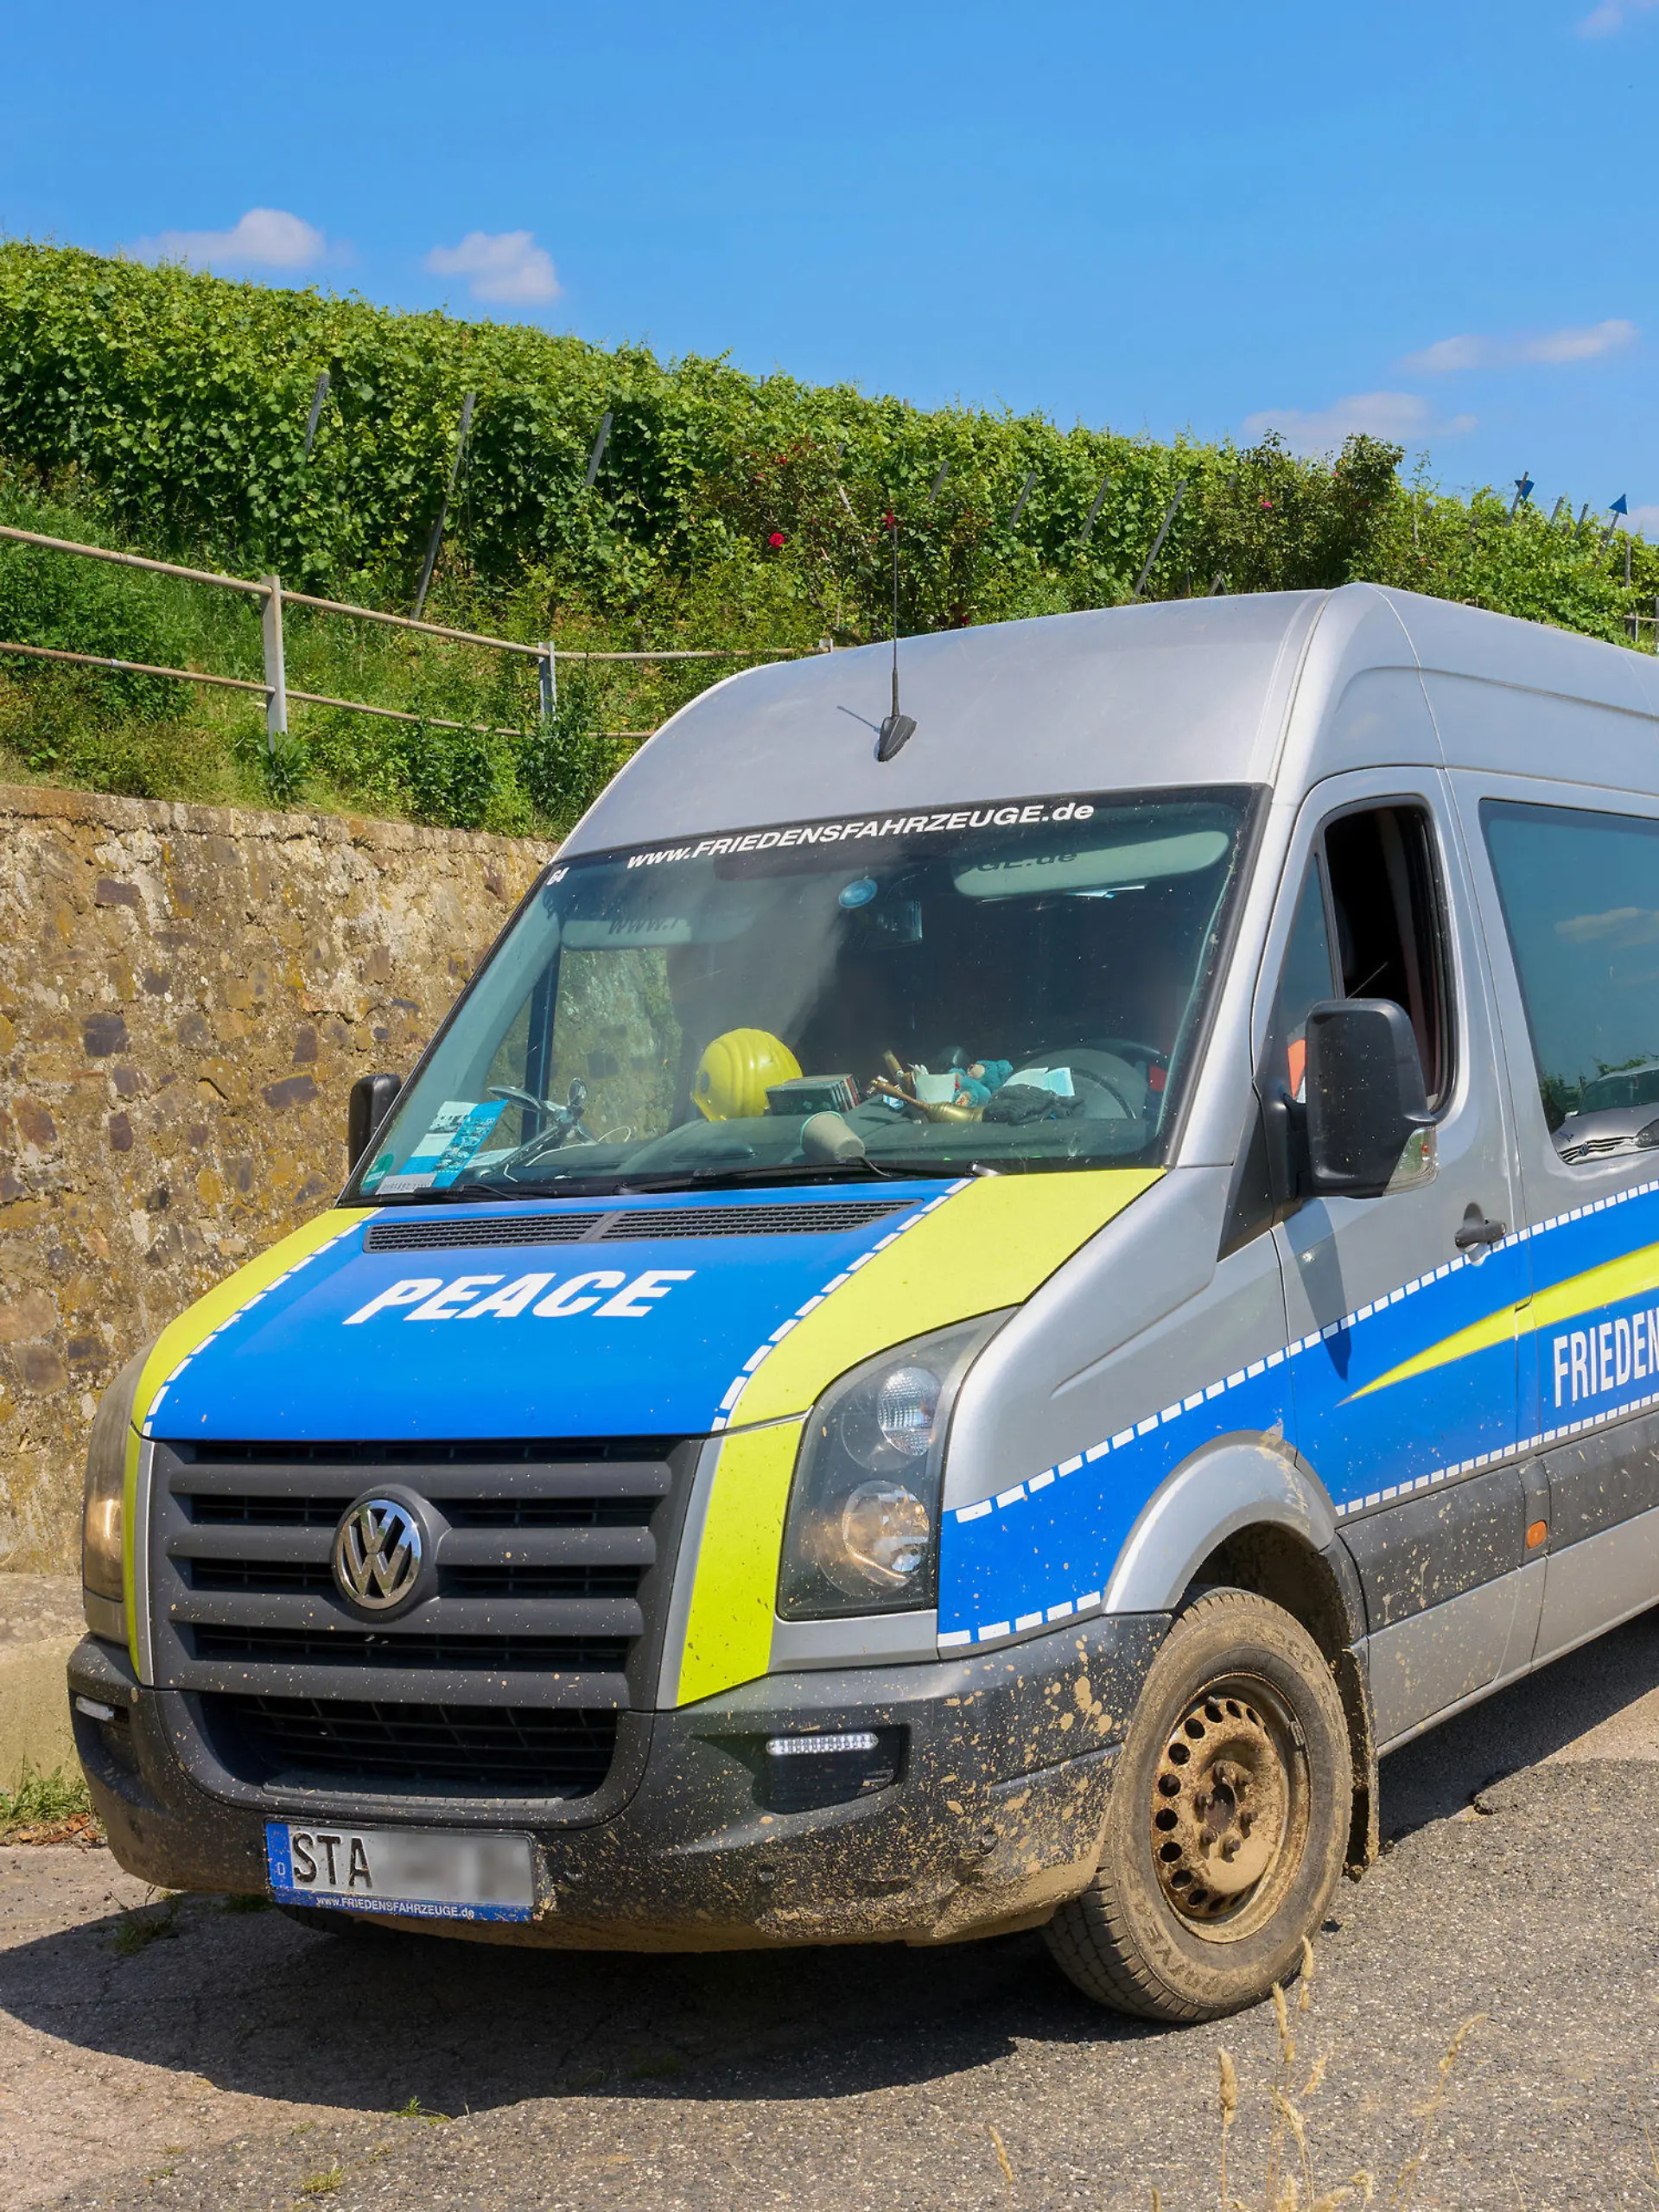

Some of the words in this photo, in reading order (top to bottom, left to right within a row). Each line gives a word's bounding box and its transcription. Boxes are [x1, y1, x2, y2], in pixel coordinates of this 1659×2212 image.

[626, 802, 1095, 869] www.FRIEDENSFAHRZEUGE.de
[342, 1269, 696, 1325] PEACE
[291, 1832, 373, 1889] STA
[315, 1896, 475, 1919] www.FRIEDENSFAHRZEUGE.de
